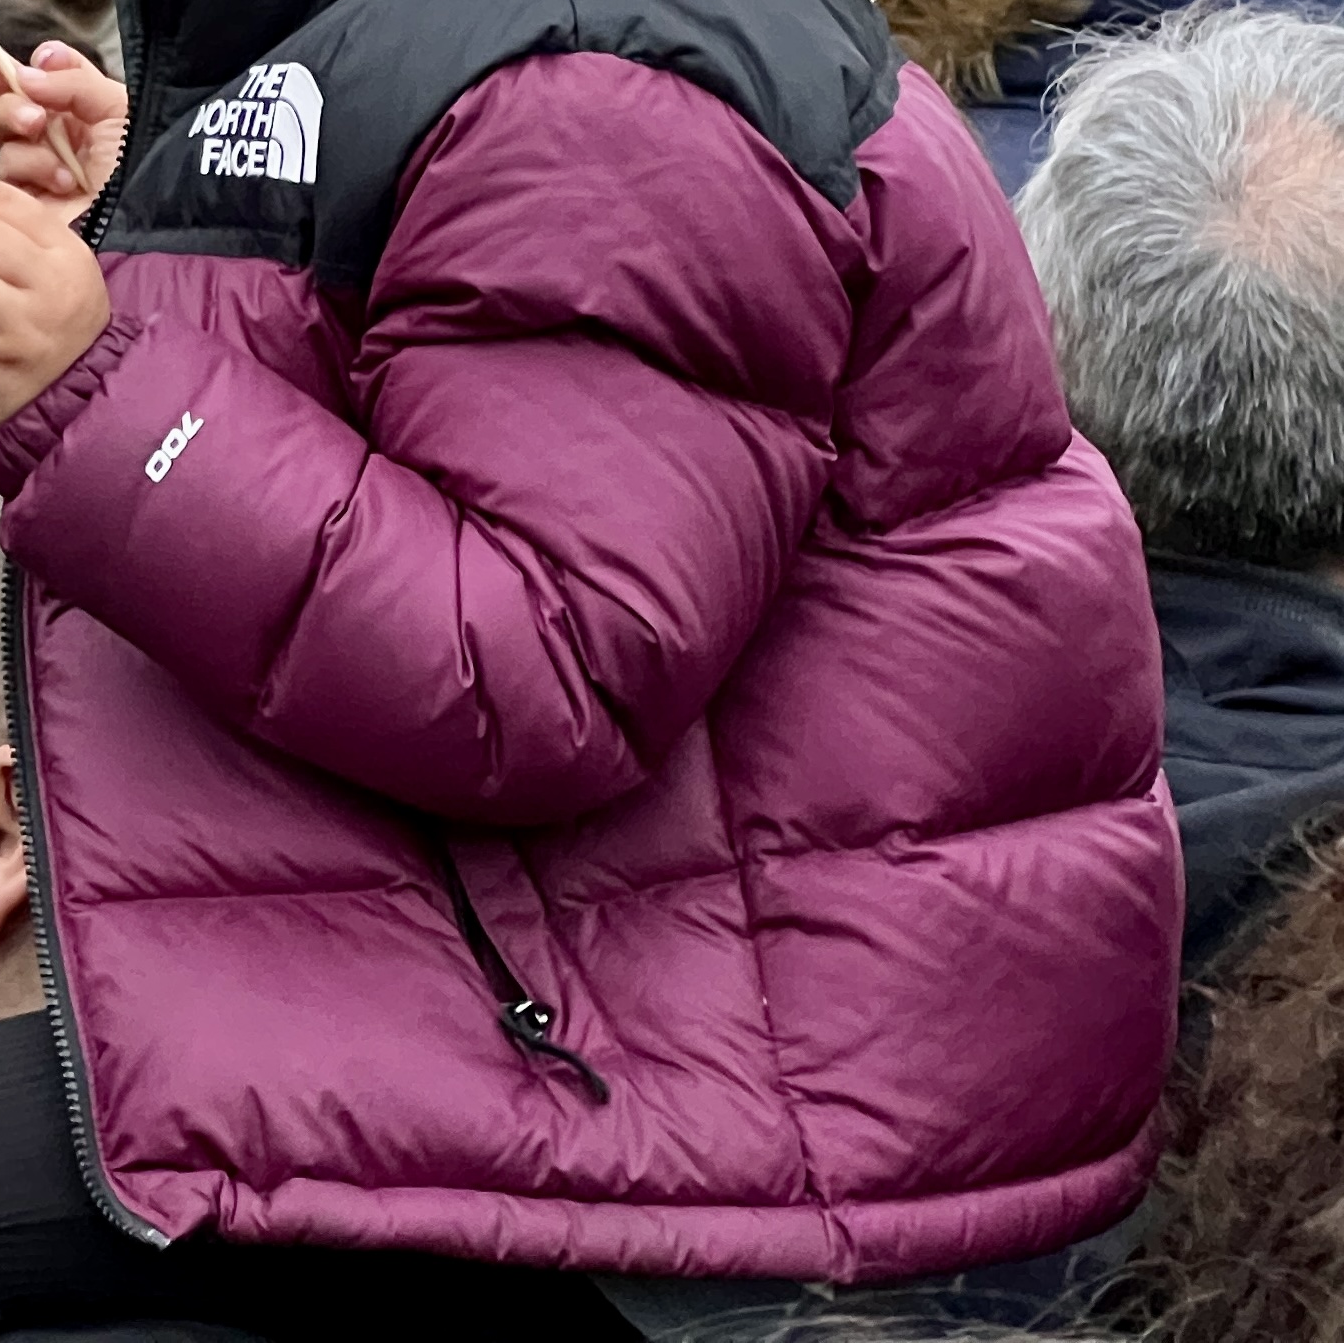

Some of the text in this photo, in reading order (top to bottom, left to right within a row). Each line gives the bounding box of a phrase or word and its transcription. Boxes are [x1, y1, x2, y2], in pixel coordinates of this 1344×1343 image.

[238, 63, 289, 98] THE
[188, 99, 275, 138] NORTH
[200, 138, 268, 177] FACE
[144, 411, 206, 483] 700
